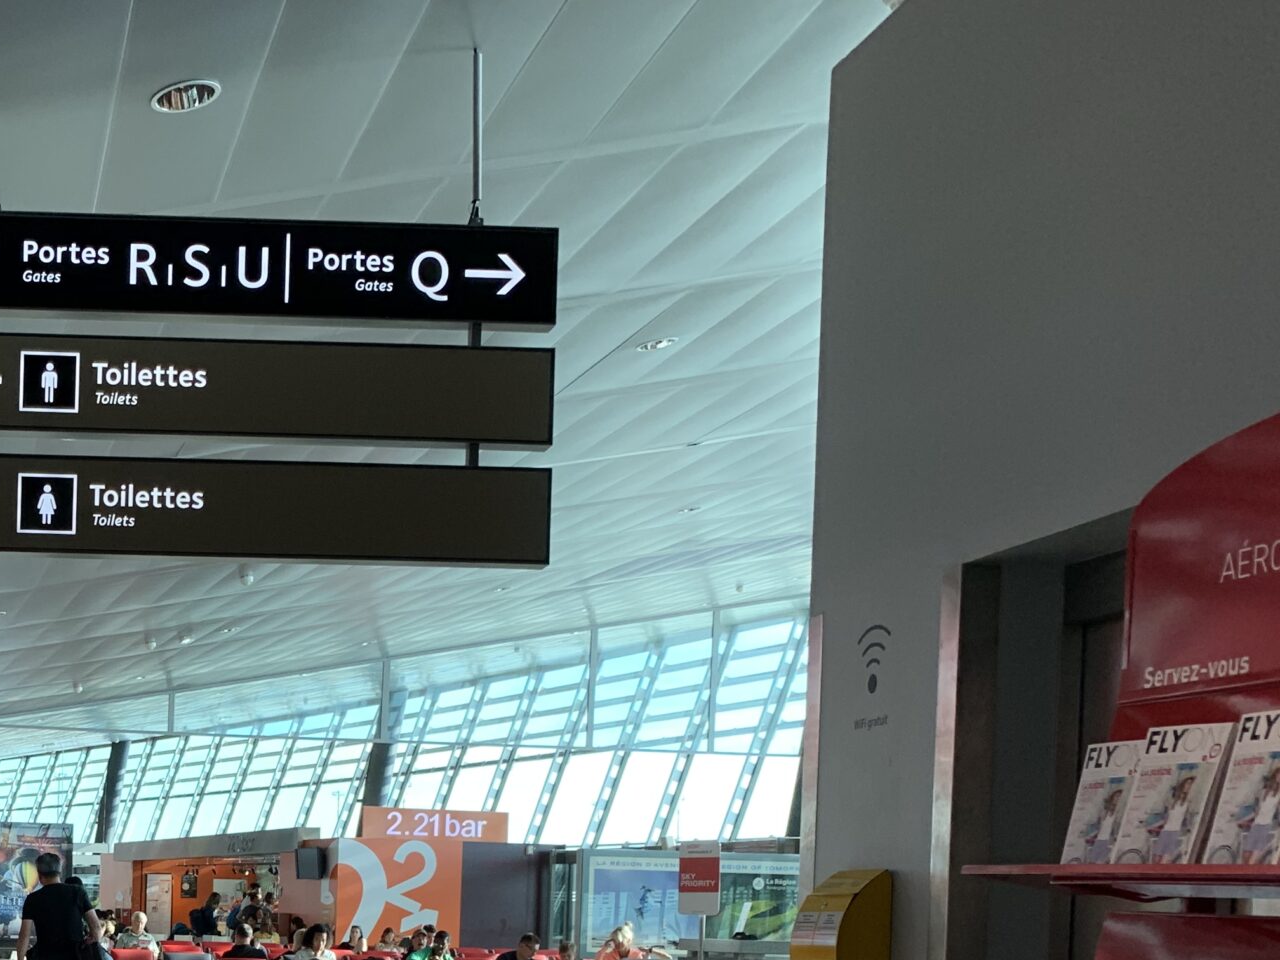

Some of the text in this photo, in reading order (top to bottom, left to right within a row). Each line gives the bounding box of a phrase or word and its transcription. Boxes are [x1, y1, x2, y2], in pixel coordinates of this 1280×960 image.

[22, 239, 110, 265] Portes
[22, 269, 62, 284] Gates
[307, 247, 450, 302] Portes Q
[354, 278, 394, 292] Gates
[91, 361, 208, 388] Toilettes
[95, 391, 139, 406] Toilets
[89, 483, 205, 509] Toilettes
[92, 513, 136, 527] Toilets
[1143, 655, 1250, 689] Servez-vous
[1238, 712, 1280, 743] FLY
[385, 811, 488, 838] 2.21 bar
[680, 872, 697, 880] SKY
[680, 880, 717, 888] PRIORITY
